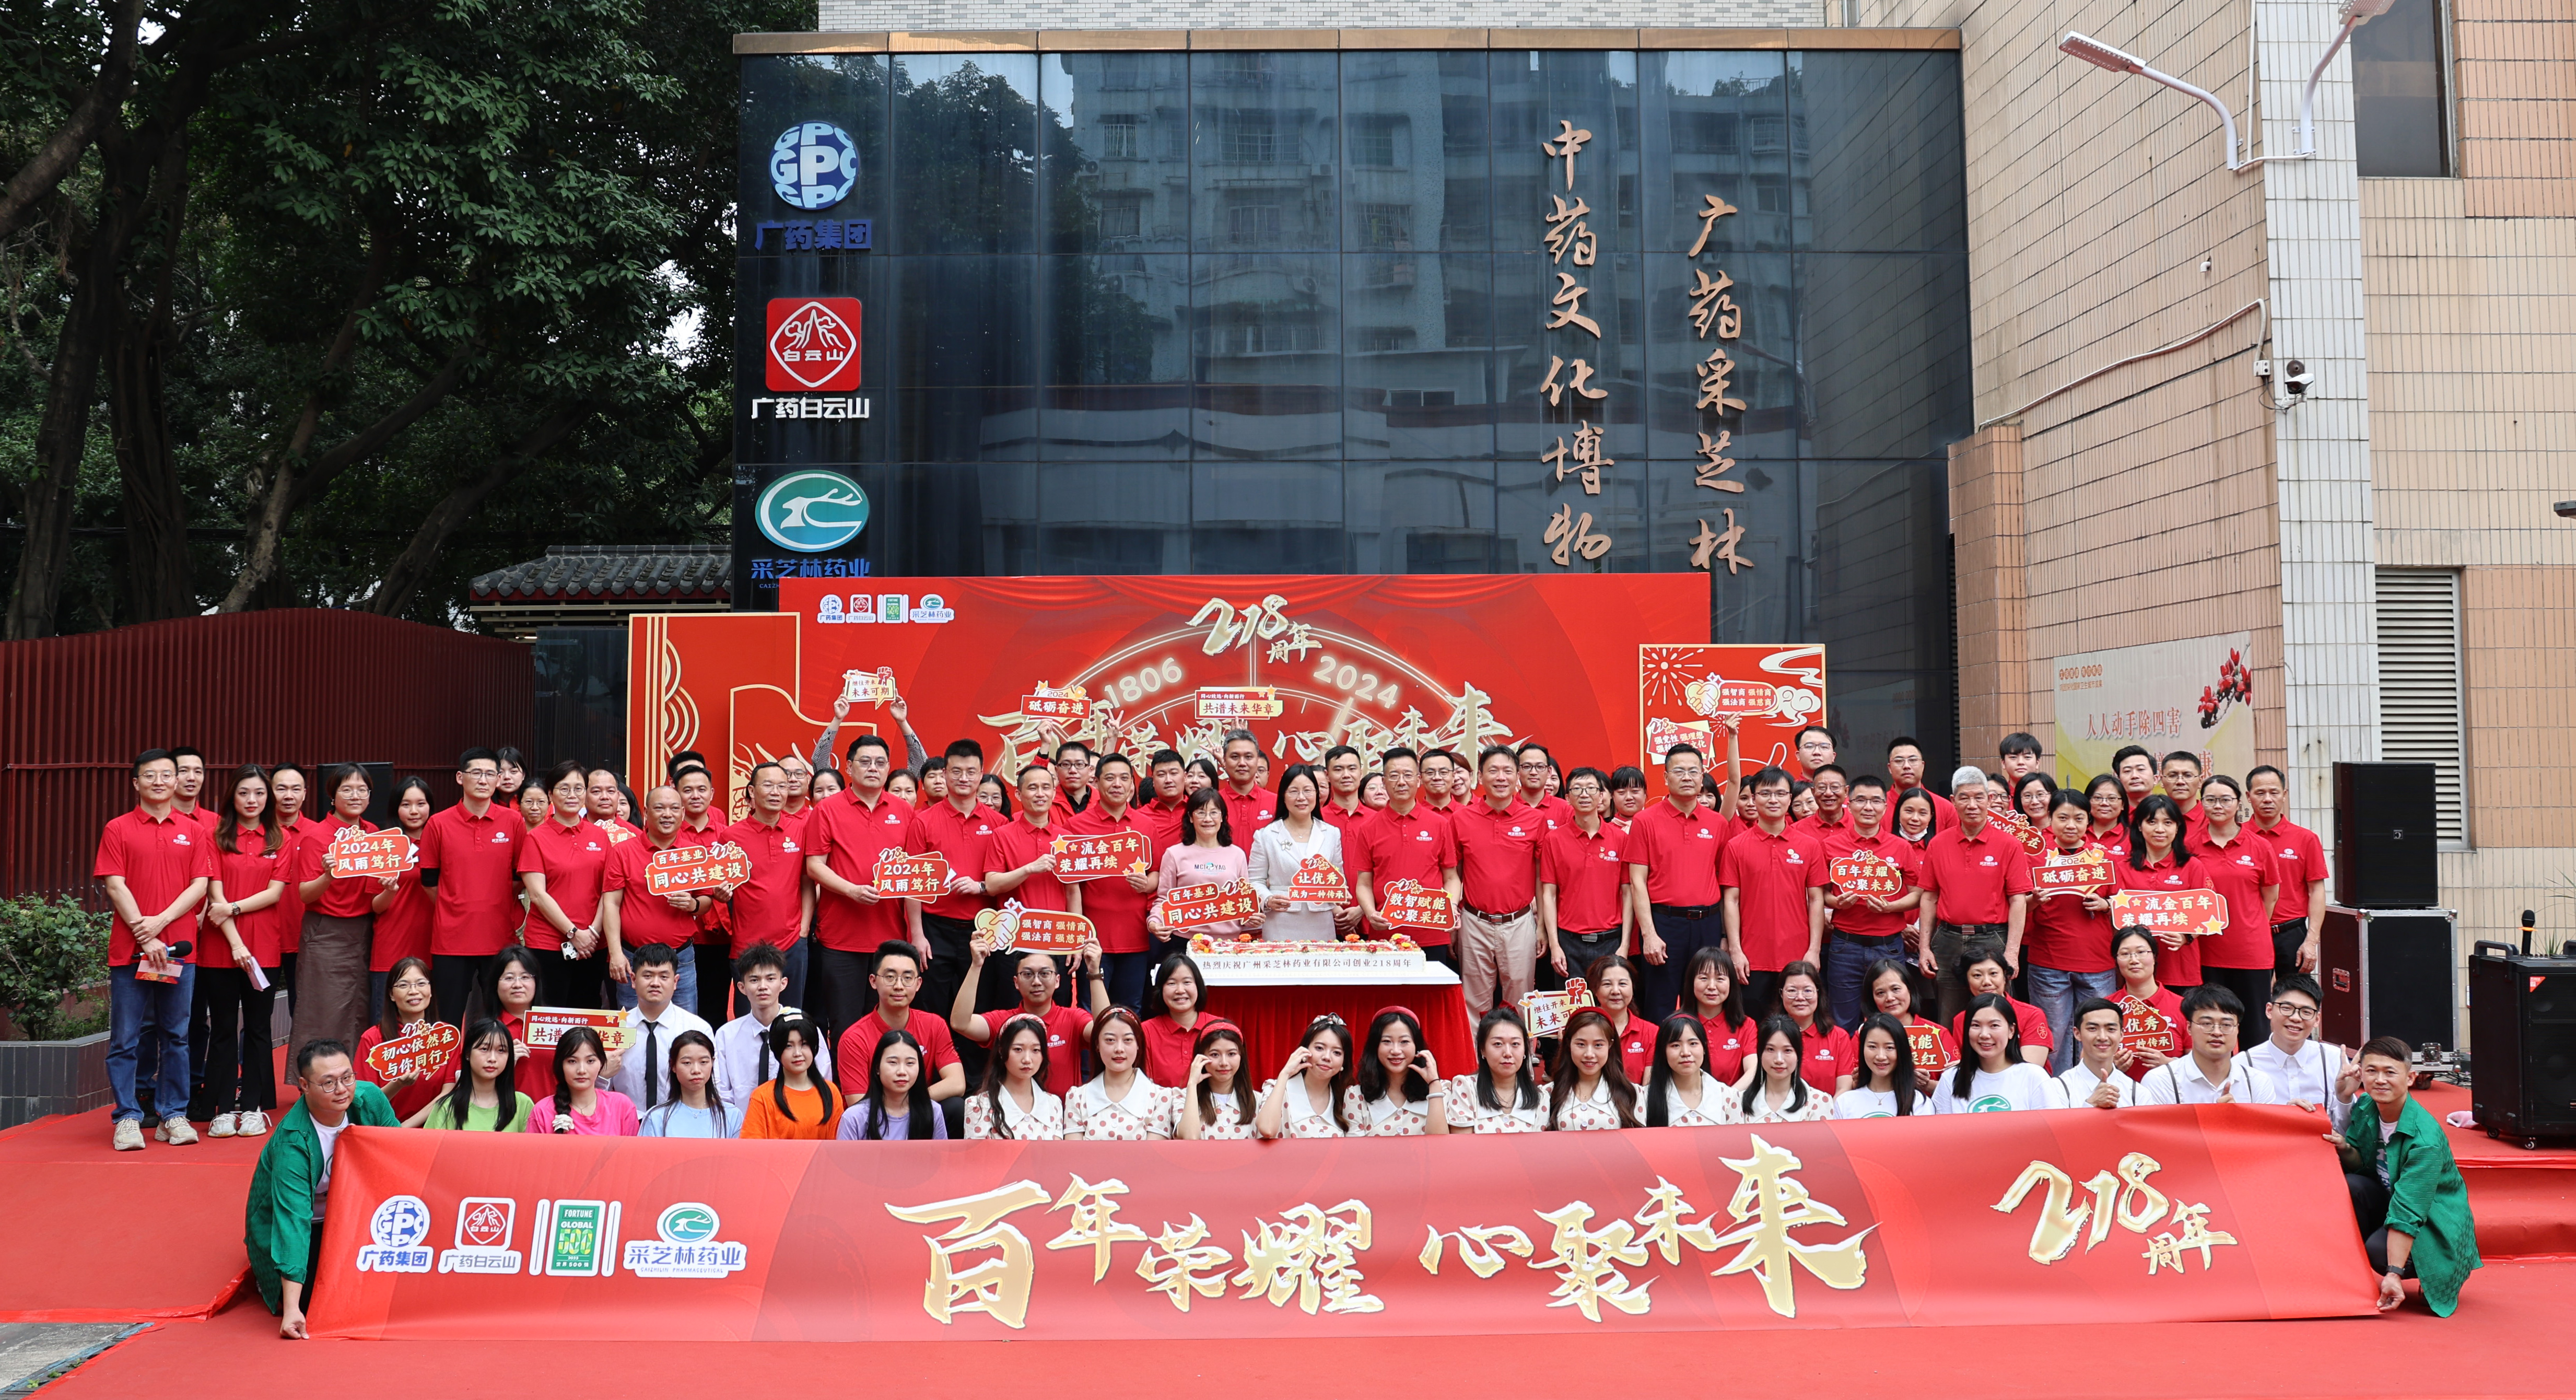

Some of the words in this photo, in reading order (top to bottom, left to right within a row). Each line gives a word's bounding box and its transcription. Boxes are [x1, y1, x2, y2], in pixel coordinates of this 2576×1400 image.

[755, 219, 872, 250] 广药集团
[1540, 120, 1614, 566] 中药文化博物
[782, 349, 844, 361] 白云山
[1689, 194, 1754, 575] 广药采芝林
[751, 398, 869, 418] 广药白云山
[751, 558, 870, 578] 采芝林药业
[1105, 657, 1182, 708] 1806
[1313, 656, 1399, 709] 2024
[851, 686, 889, 698] 未来可期
[1722, 688, 1746, 696] 强智商
[1028, 701, 1084, 715] 砥砺奋进
[1203, 703, 1274, 715] 共谱未来华章
[2086, 707, 2181, 738] 人人动手除四害
[341, 839, 395, 854] 2024年
[1081, 838, 1140, 854] 流金百年
[338, 854, 402, 871] 风雨笃行
[657, 848, 704, 865] 百年基业
[1060, 856, 1118, 872] 荣耀再续
[654, 863, 744, 889] 同心共建设
[884, 862, 935, 876] 2024年
[1836, 864, 1889, 878] 百年荣耀
[2042, 866, 2107, 883] 砥砺奋进
[880, 877, 939, 892] 风雨笃行
[1297, 871, 1339, 885] 让优秀
[1842, 880, 1896, 891] 心聚未来
[1171, 886, 1216, 901] 百年基业
[1291, 890, 1344, 899] 成为一种传承
[1390, 893, 1446, 910] 数智赋能
[1168, 898, 1255, 924] 同心共建设
[2145, 895, 2213, 911] 流金百年
[1390, 909, 1447, 924] 心聚采红
[2122, 912, 2188, 926] 荣耀再续
[1022, 919, 1052, 930] 强智商
[1056, 921, 1086, 932] 强情商
[1021, 931, 1051, 942] 强法商
[1055, 933, 1085, 944] 强慈商
[1202, 959, 1412, 970] 热烈庆祝广州采芝林药业有限公司创业218周年
[1533, 999, 1567, 1013] 继往开来
[1536, 1006, 1586, 1029] 未来可
[2123, 1016, 2159, 1032] 优秀
[382, 1028, 454, 1060] 初心依然在
[533, 1027, 625, 1046] 共谱华章
[385, 1050, 442, 1076] 与你同行
[565, 1209, 593, 1218] FORTUNE
[884, 1172, 1384, 1330] 百年荣耀
[1420, 1131, 1883, 1322] 心聚未来
[558, 1229, 593, 1255] 500
[362, 1251, 428, 1267] 广药集团
[444, 1255, 516, 1268] 广药白云山
[629, 1246, 741, 1265] 采芝林药业
